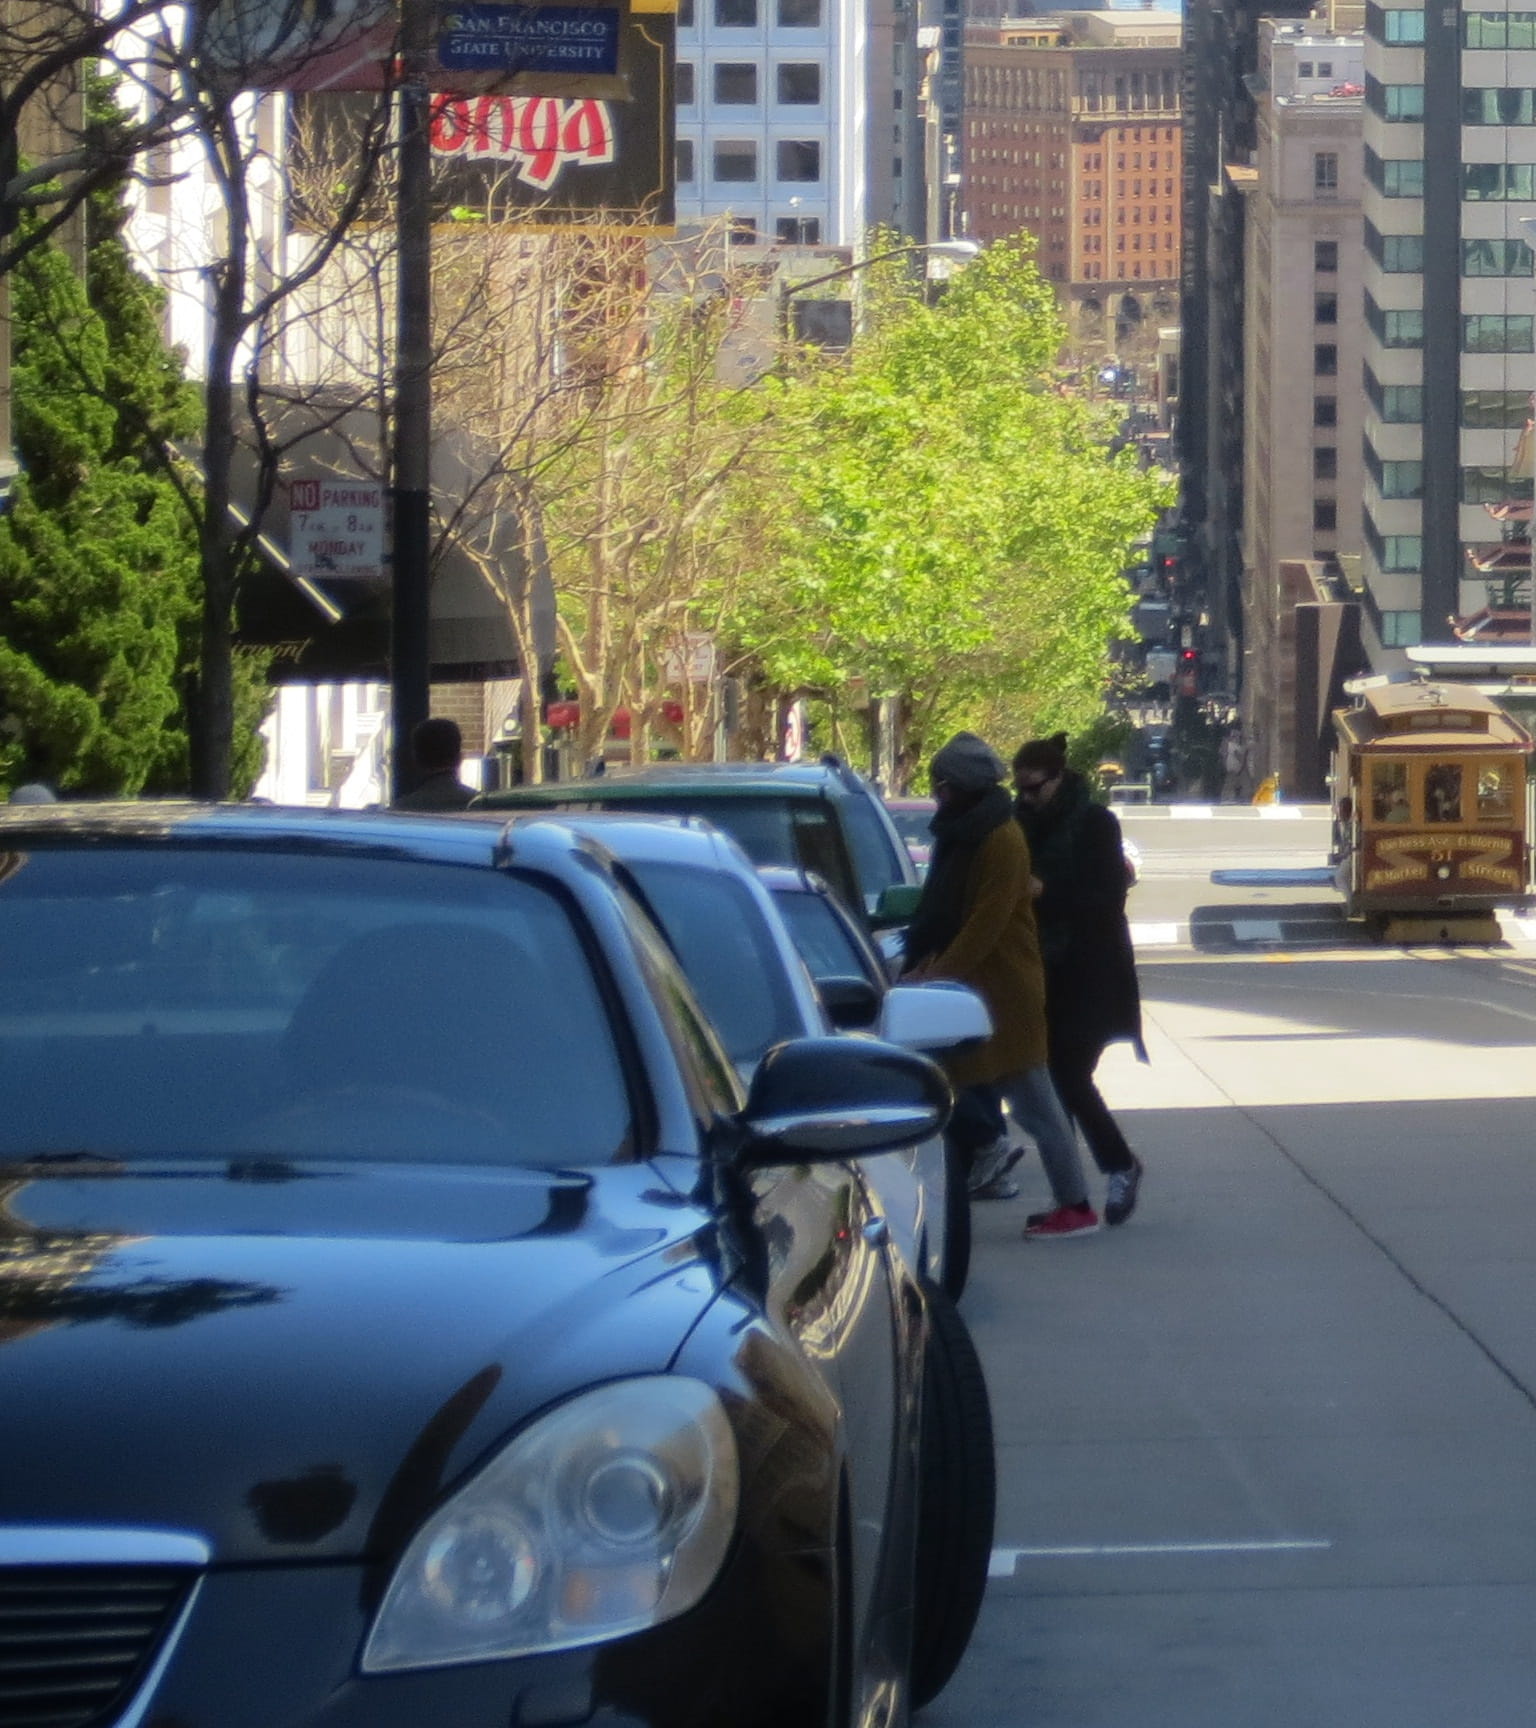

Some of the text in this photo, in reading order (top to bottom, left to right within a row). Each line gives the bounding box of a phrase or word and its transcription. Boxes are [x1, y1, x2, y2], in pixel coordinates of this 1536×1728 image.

[293, 483, 380, 508] NO PARKING
[309, 540, 365, 557] MONDAY
